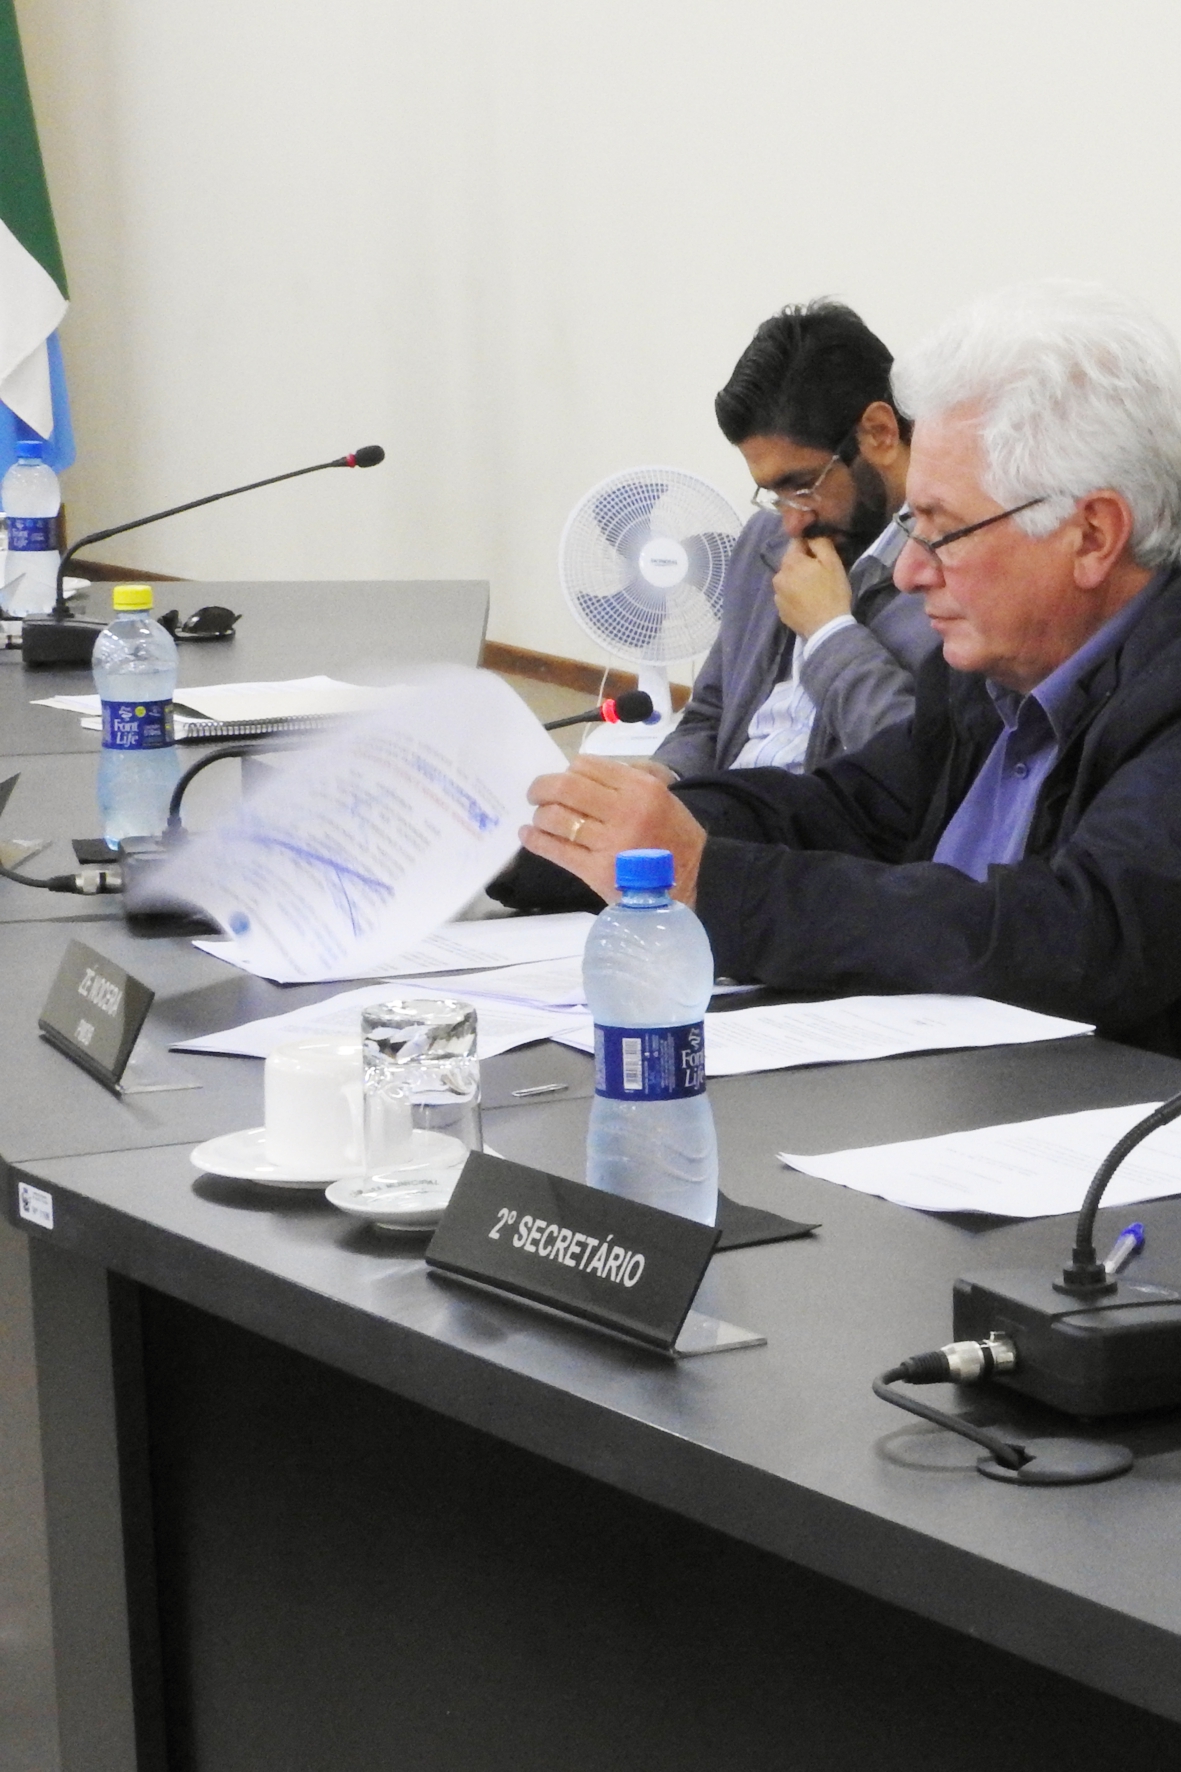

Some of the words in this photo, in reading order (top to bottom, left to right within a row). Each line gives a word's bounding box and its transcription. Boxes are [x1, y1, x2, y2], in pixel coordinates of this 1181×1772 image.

[114, 719, 139, 732] Font
[116, 732, 139, 747] Life
[78, 964, 98, 997] ZÉ
[386, 1179, 439, 1189] MUNICIPAL
[488, 1207, 517, 1240] 2º
[512, 1215, 645, 1288] SECRETÁRIO
